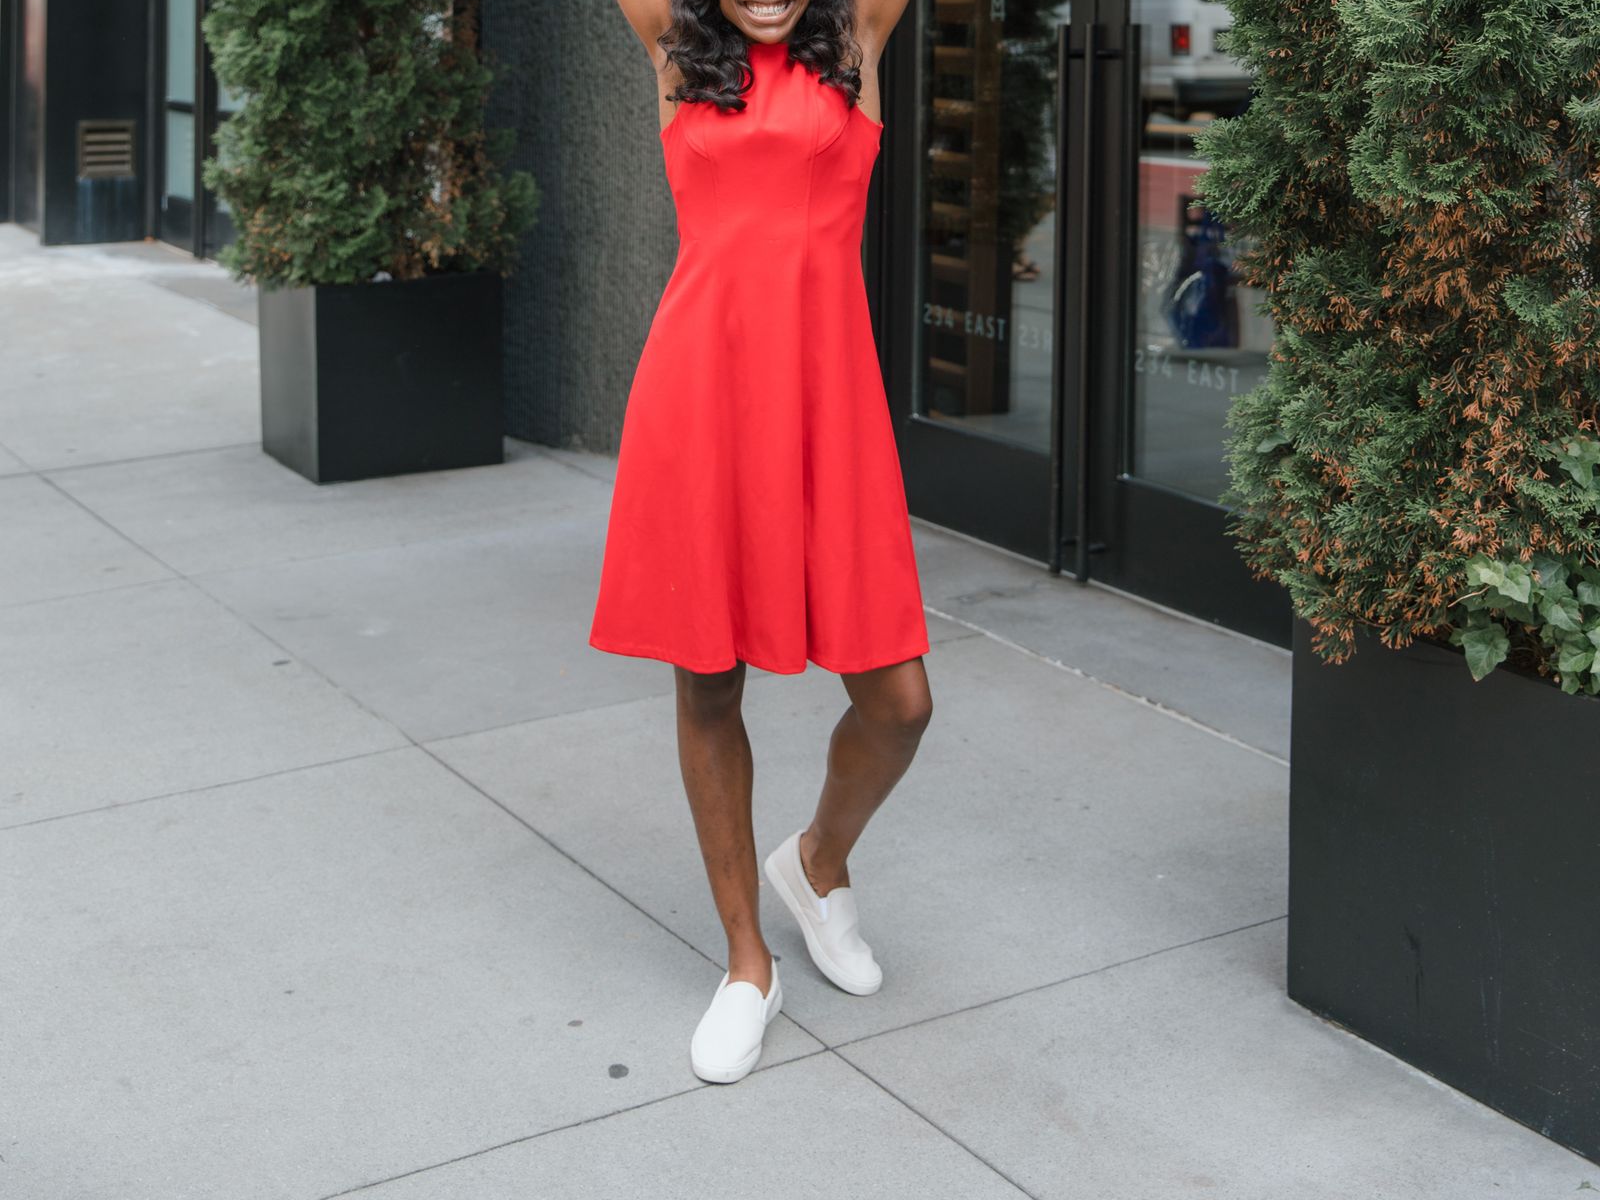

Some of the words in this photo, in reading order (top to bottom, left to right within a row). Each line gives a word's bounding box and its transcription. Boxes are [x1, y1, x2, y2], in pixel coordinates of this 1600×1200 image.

[922, 302, 954, 329] 234
[965, 311, 1007, 341] EAST
[1135, 349, 1172, 378] 234
[1187, 360, 1240, 393] EAST
